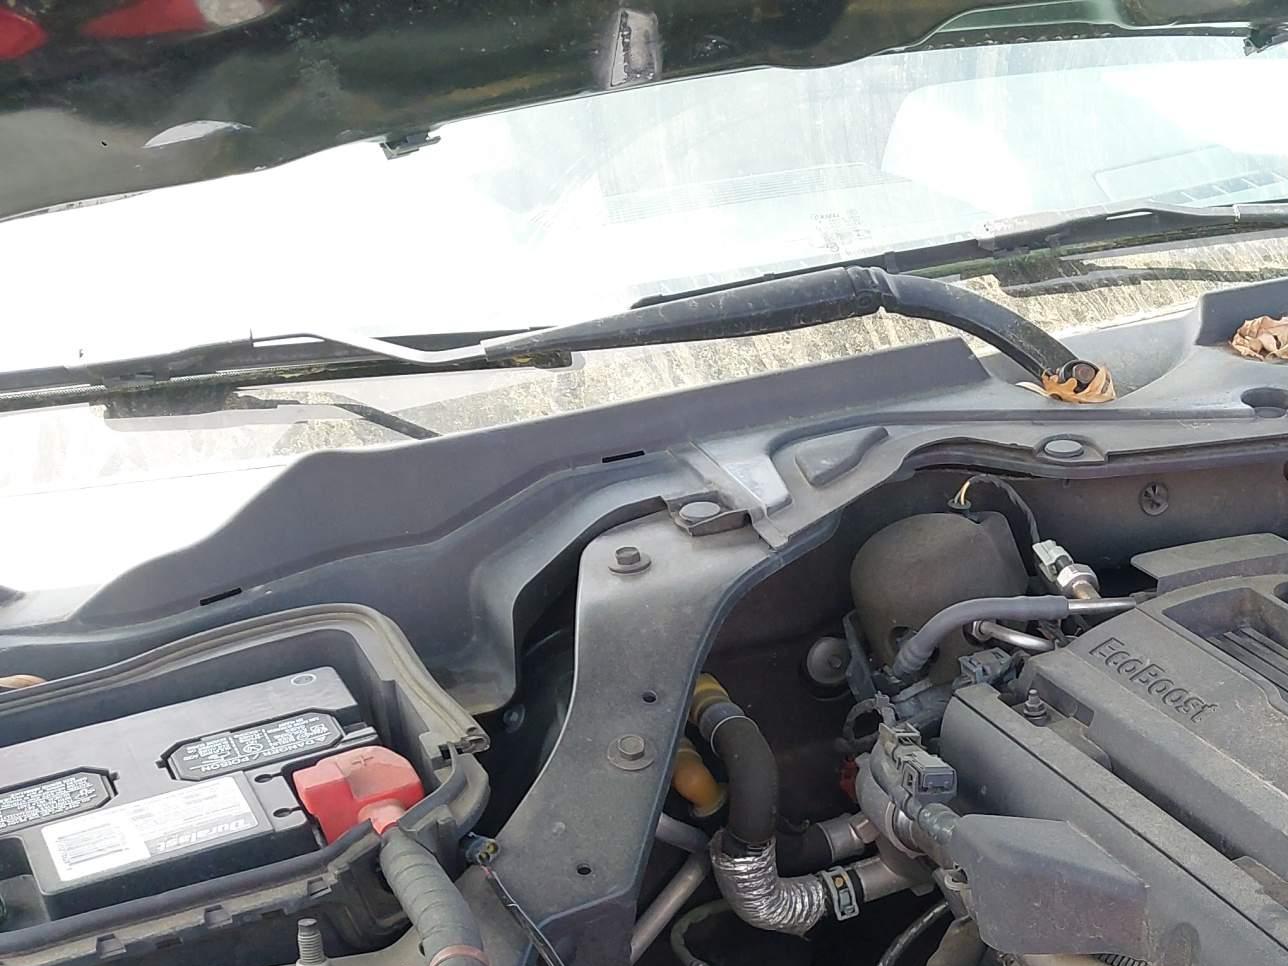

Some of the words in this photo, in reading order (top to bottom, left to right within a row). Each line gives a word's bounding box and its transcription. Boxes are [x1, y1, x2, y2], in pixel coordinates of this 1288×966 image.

[1089, 637, 1217, 723] EcoBoost
[263, 738, 315, 757] DANGER
[201, 756, 250, 772] POISON
[157, 818, 250, 852] Duralast
